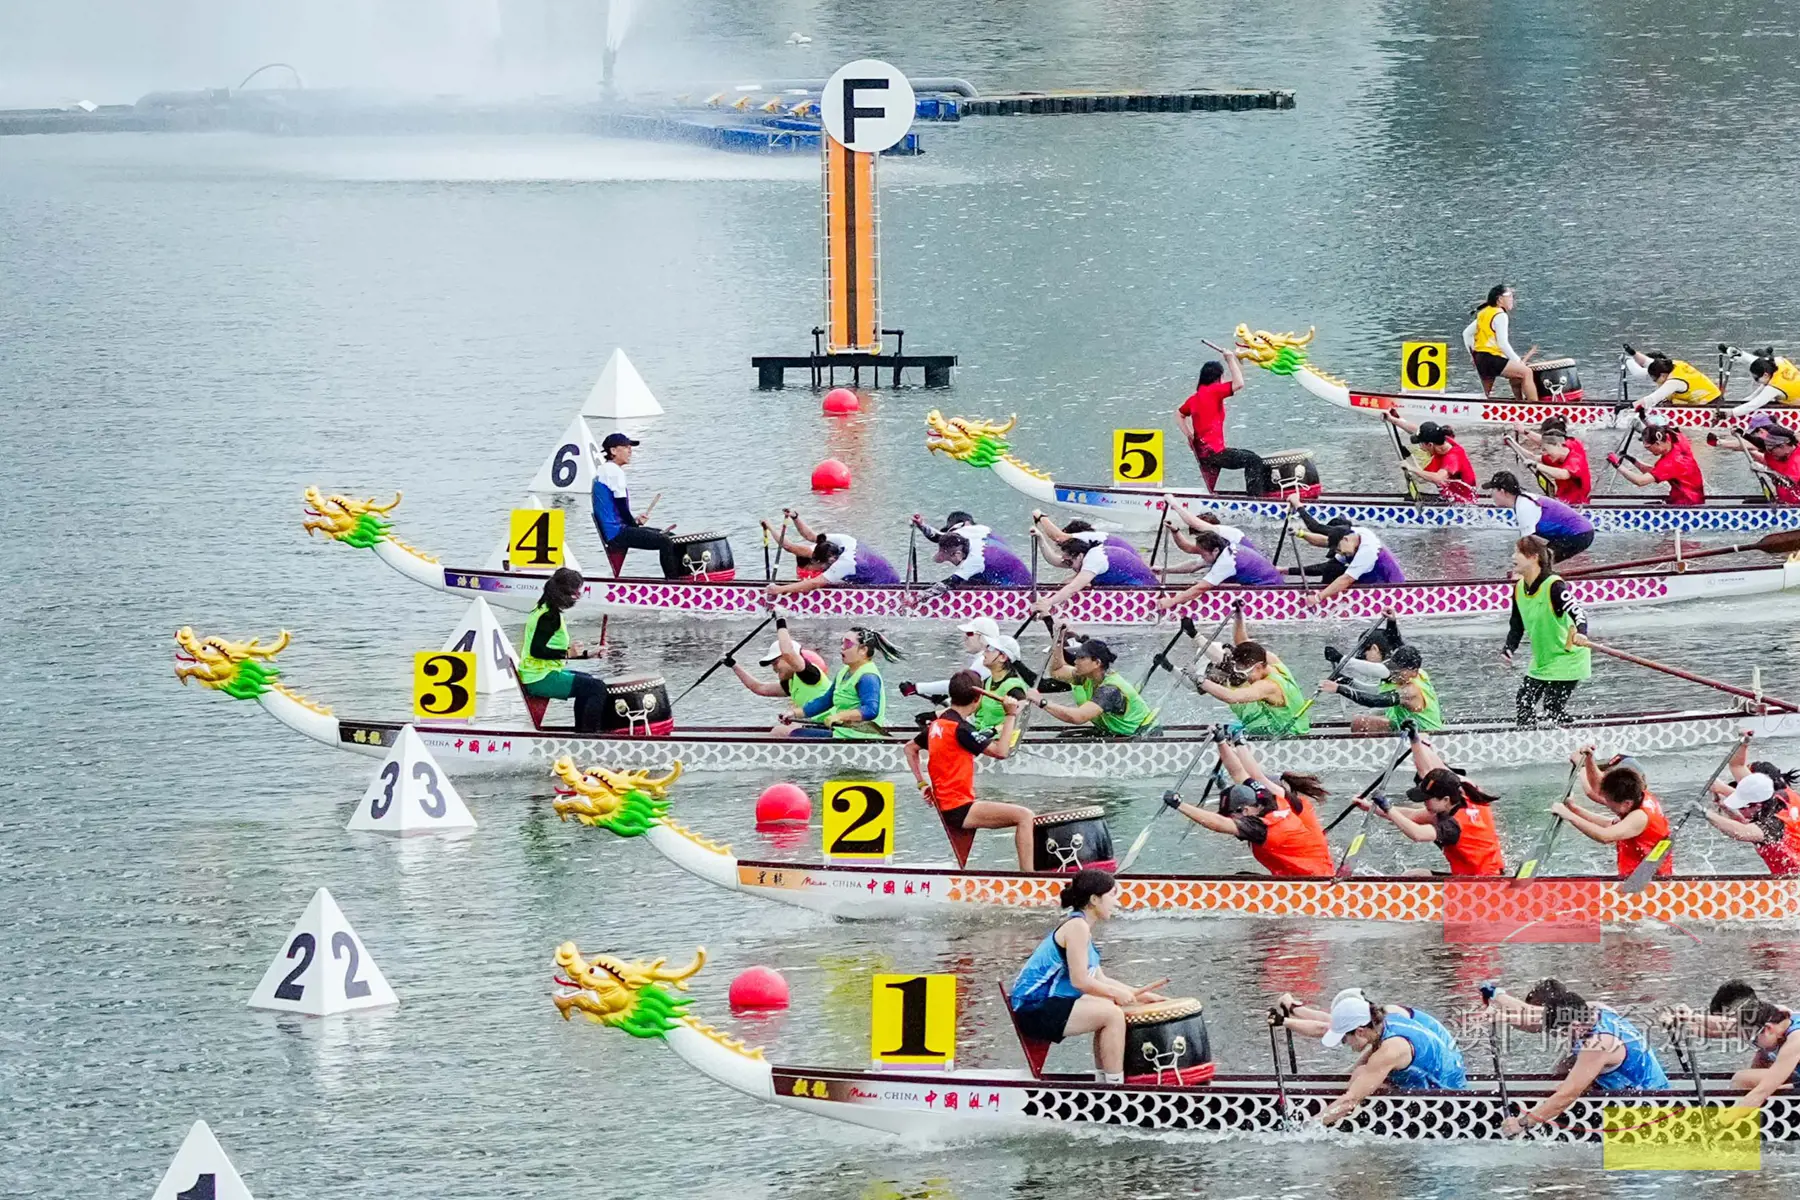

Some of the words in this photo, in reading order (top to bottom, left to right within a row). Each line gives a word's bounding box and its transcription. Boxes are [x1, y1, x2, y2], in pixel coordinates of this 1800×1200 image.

[843, 78, 889, 143] F
[1406, 345, 1440, 387] 6
[551, 443, 580, 488] 6
[1118, 432, 1157, 479] 5
[515, 512, 558, 564] 4
[419, 654, 470, 715] 3
[424, 739, 450, 748] CHINA
[370, 760, 400, 820] 3
[412, 761, 447, 819] 3
[830, 785, 886, 854] 2
[833, 880, 862, 889] CHINA
[274, 932, 316, 1001] 2
[331, 931, 372, 999] 2
[880, 977, 946, 1057] 1
[884, 1091, 918, 1102] CHINA
